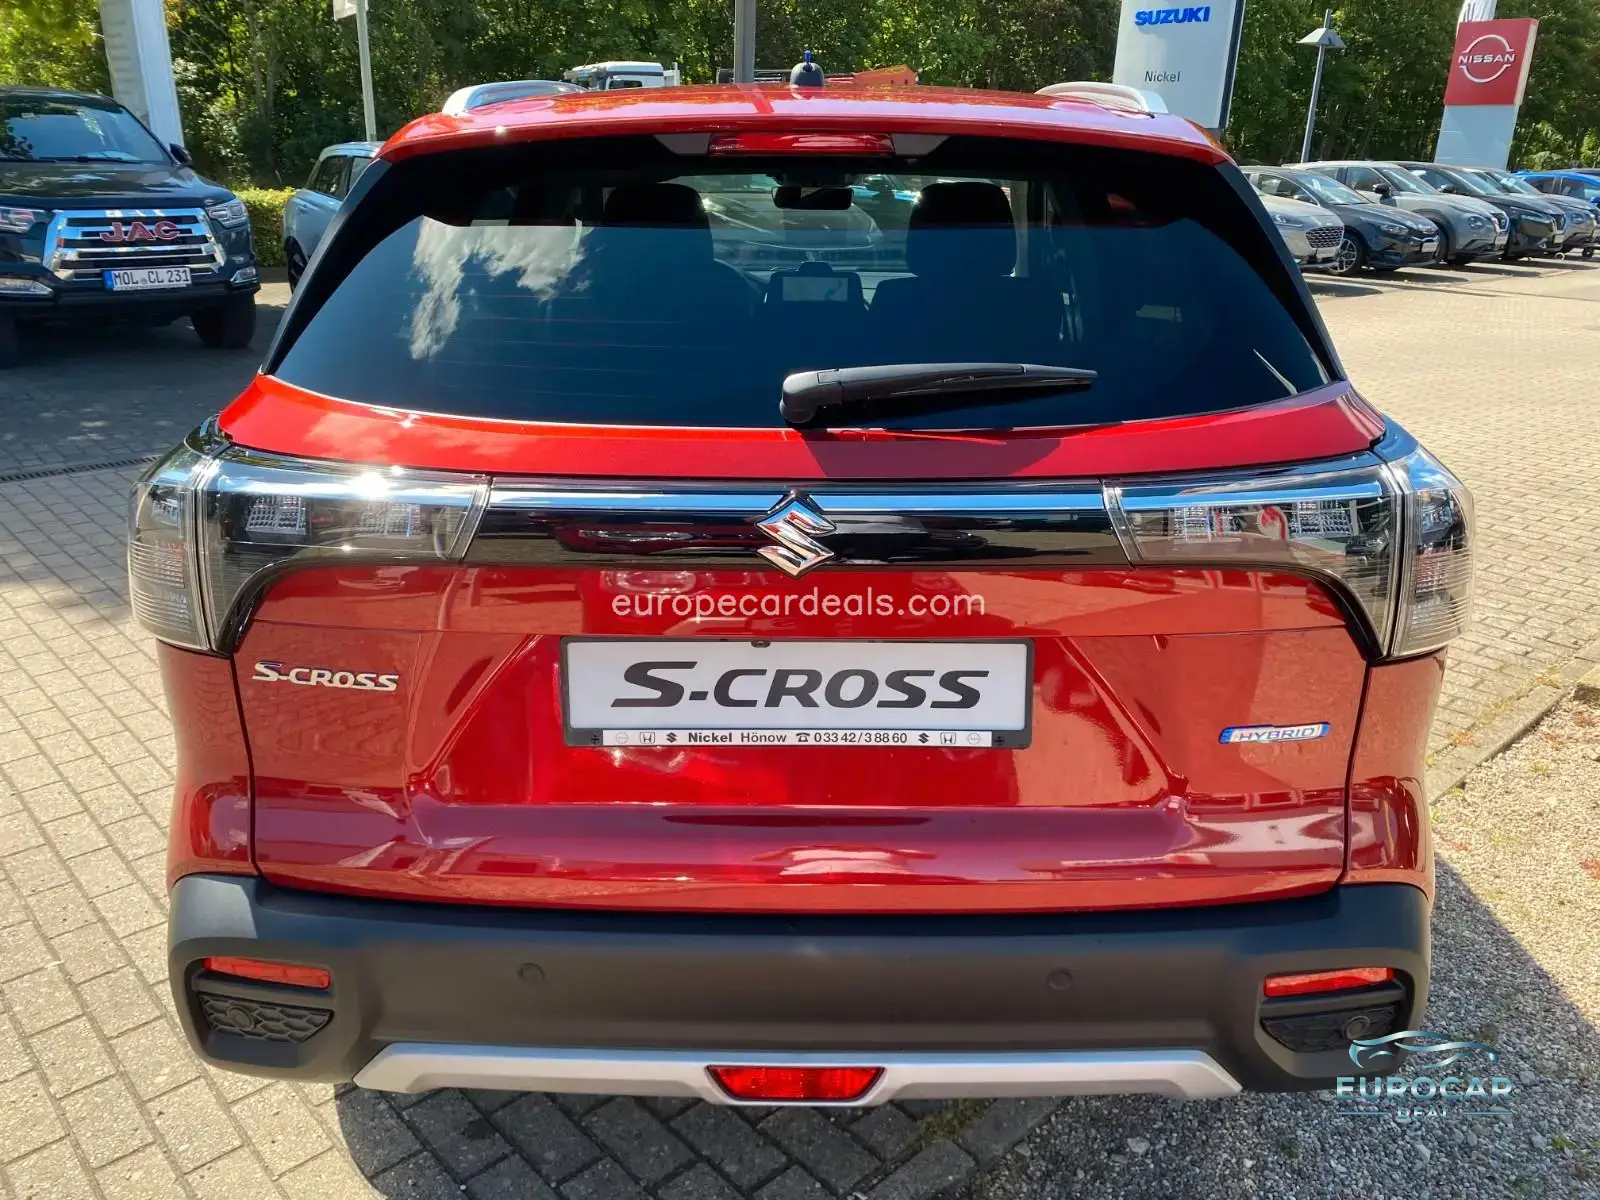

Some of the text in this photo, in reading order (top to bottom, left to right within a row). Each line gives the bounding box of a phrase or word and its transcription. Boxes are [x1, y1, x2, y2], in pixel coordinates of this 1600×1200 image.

[1135, 7, 1211, 26] SUZUKI
[1458, 53, 1515, 64] NISSAN
[1144, 70, 1181, 82] Nickel
[100, 221, 180, 242] JAC
[113, 269, 190, 286] MOL CL 231
[251, 660, 400, 692] S-CROSS
[610, 661, 990, 709] S-CROSS
[688, 732, 733, 743] Nickel
[740, 731, 787, 743] Hönow
[1239, 727, 1315, 741] HYBRID
